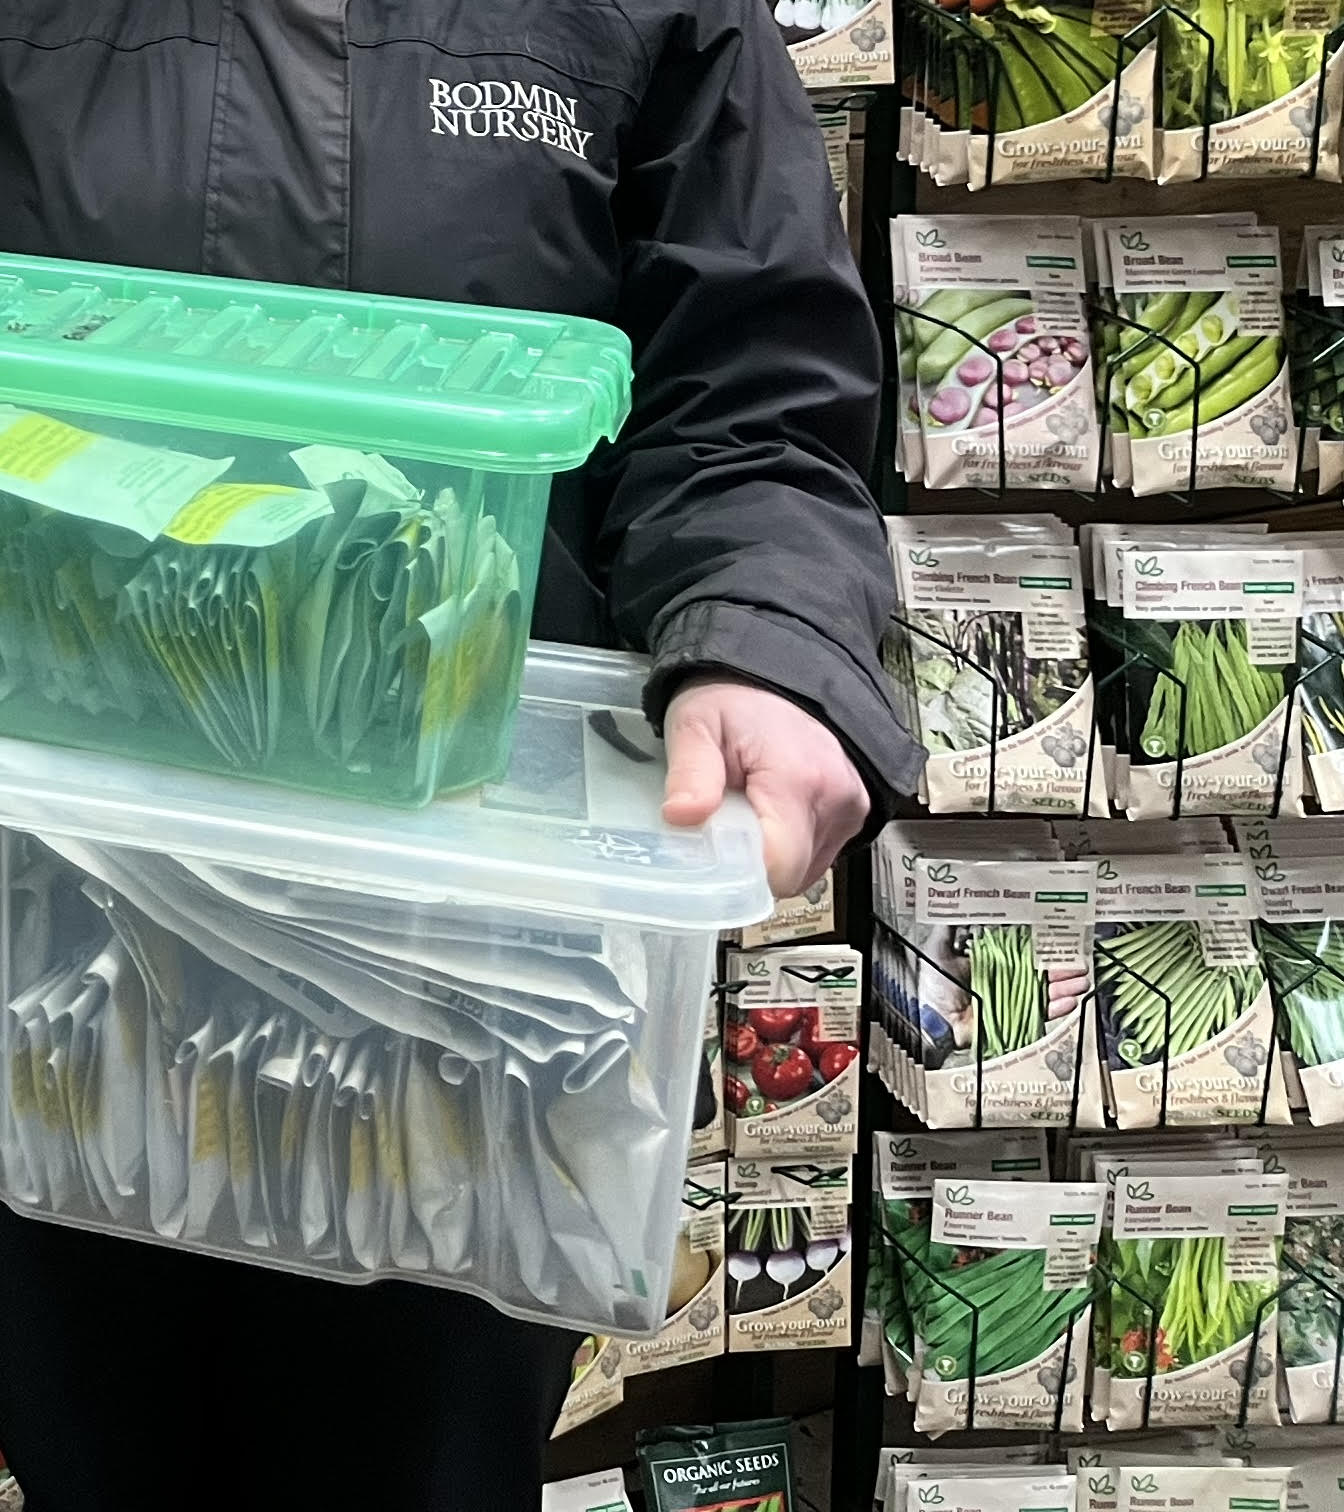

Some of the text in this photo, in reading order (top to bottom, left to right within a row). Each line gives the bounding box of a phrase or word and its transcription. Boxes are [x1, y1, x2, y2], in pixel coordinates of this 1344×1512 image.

[429, 79, 577, 125] BODMIN
[430, 106, 594, 159] NURSERY
[919, 253, 982, 263] Broad Bean
[944, 1207, 1013, 1222] Runner Bean
[664, 1453, 779, 1483] ORGANIC SEEDS
